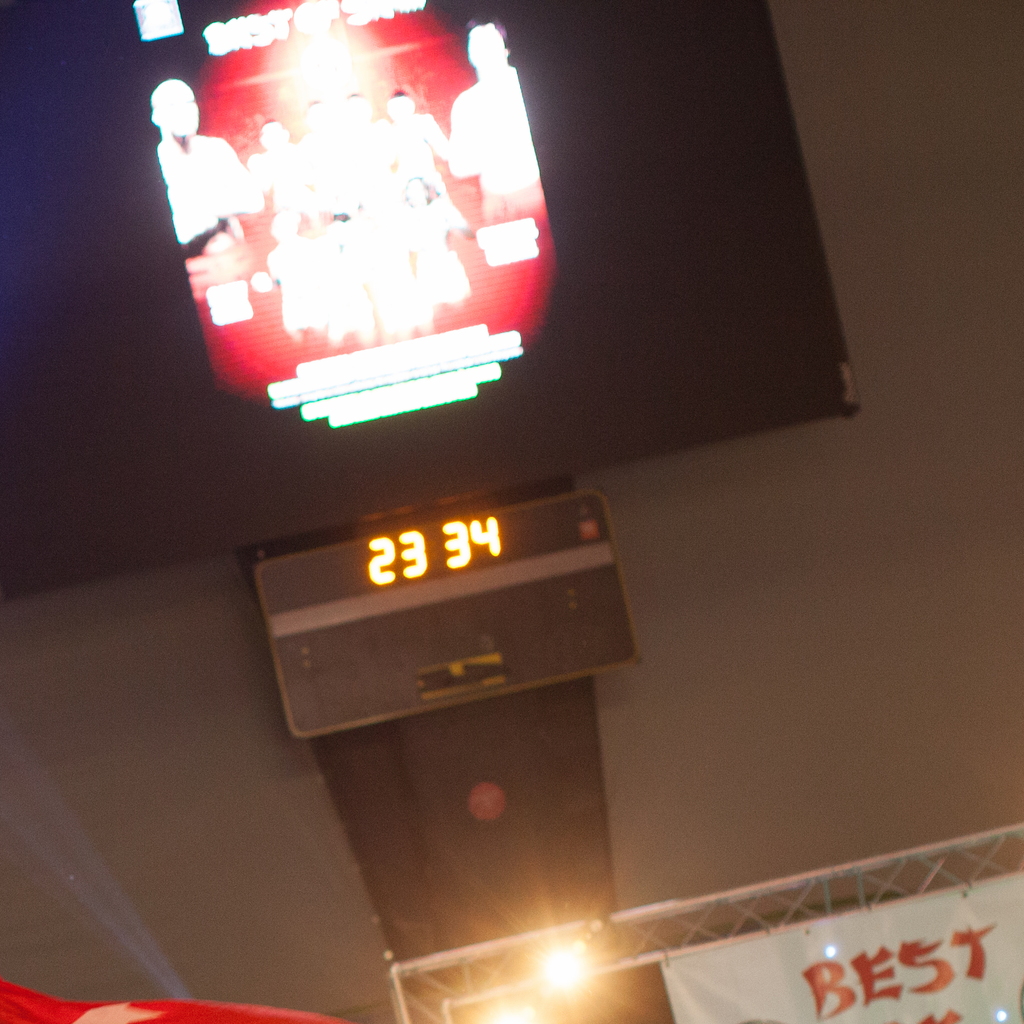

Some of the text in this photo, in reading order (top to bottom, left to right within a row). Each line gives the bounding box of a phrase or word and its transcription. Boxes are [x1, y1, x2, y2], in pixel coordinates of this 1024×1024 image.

[369, 516, 502, 586] 23 34
[802, 922, 998, 1022] BEST
